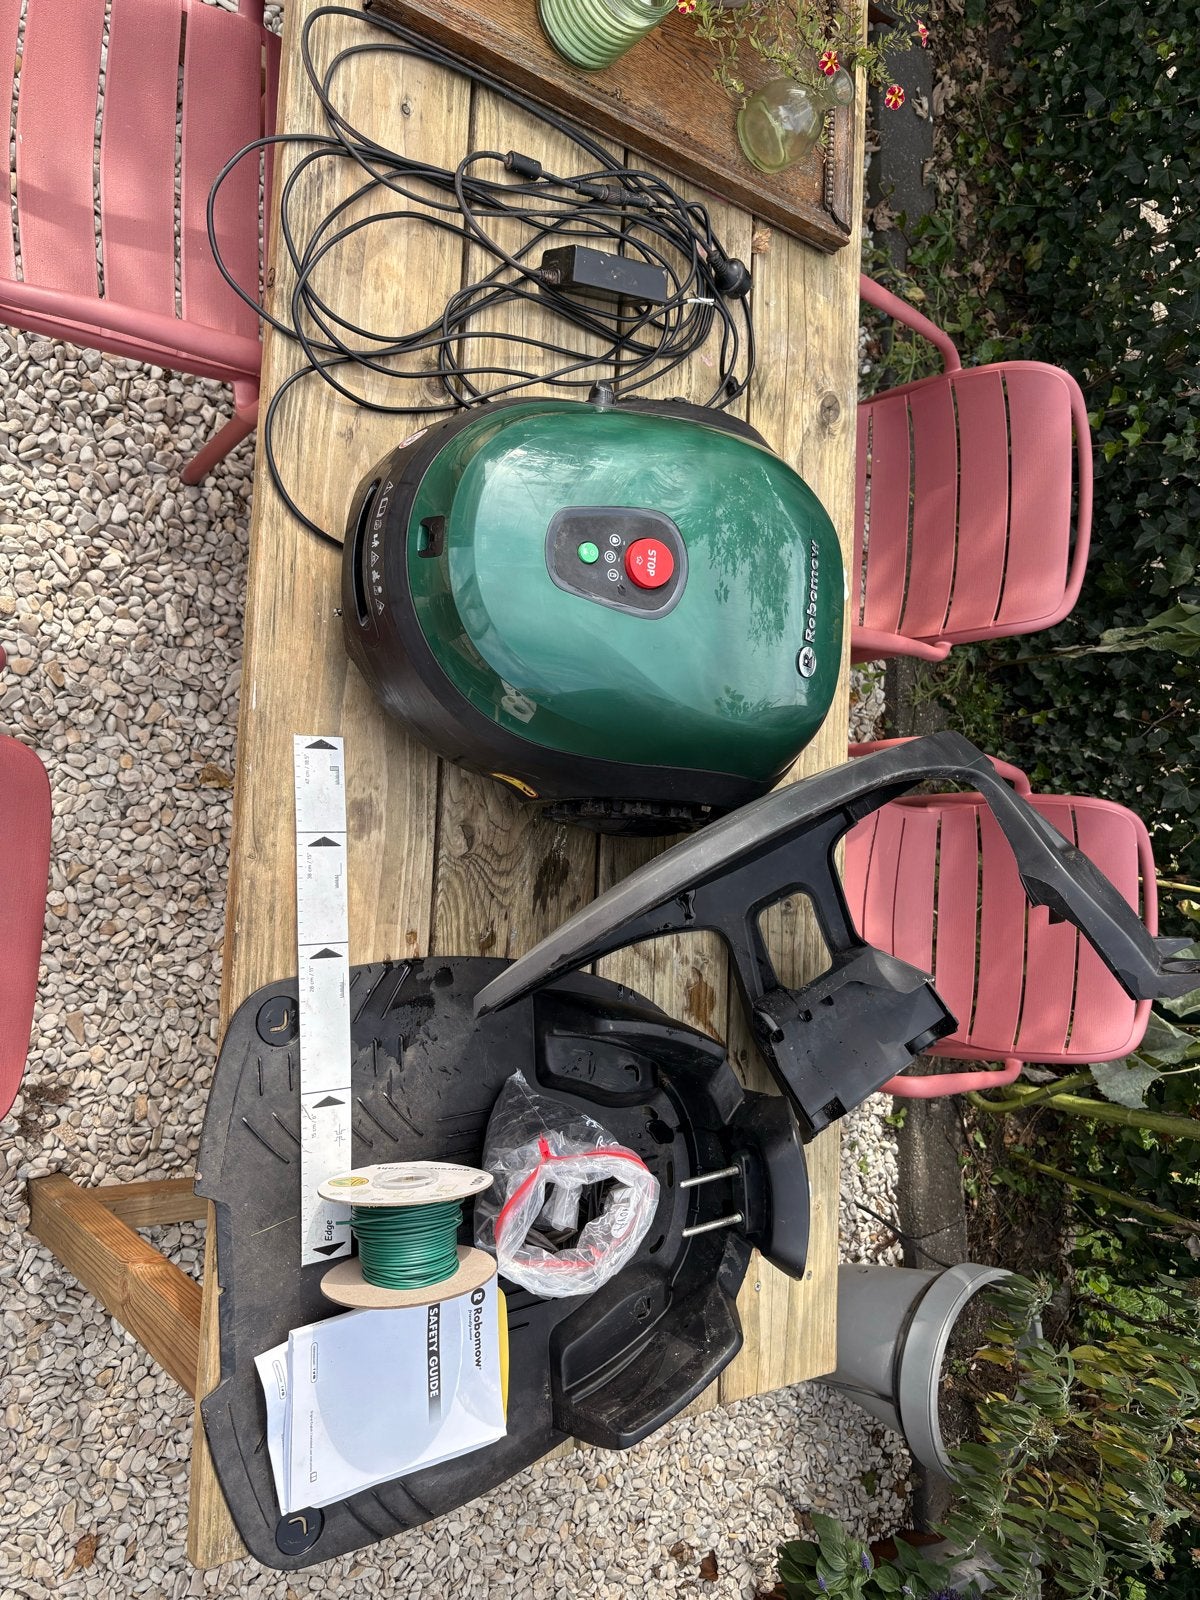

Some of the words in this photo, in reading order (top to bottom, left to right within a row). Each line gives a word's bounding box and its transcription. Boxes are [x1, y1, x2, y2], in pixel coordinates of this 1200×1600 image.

[646, 548, 657, 576] STOP
[804, 539, 819, 644] Robomow
[324, 1219, 333, 1241] Edge
[428, 1307, 440, 1351] SAFETY
[473, 1306, 483, 1368] Robomow
[428, 1356, 440, 1398] GUIDE
